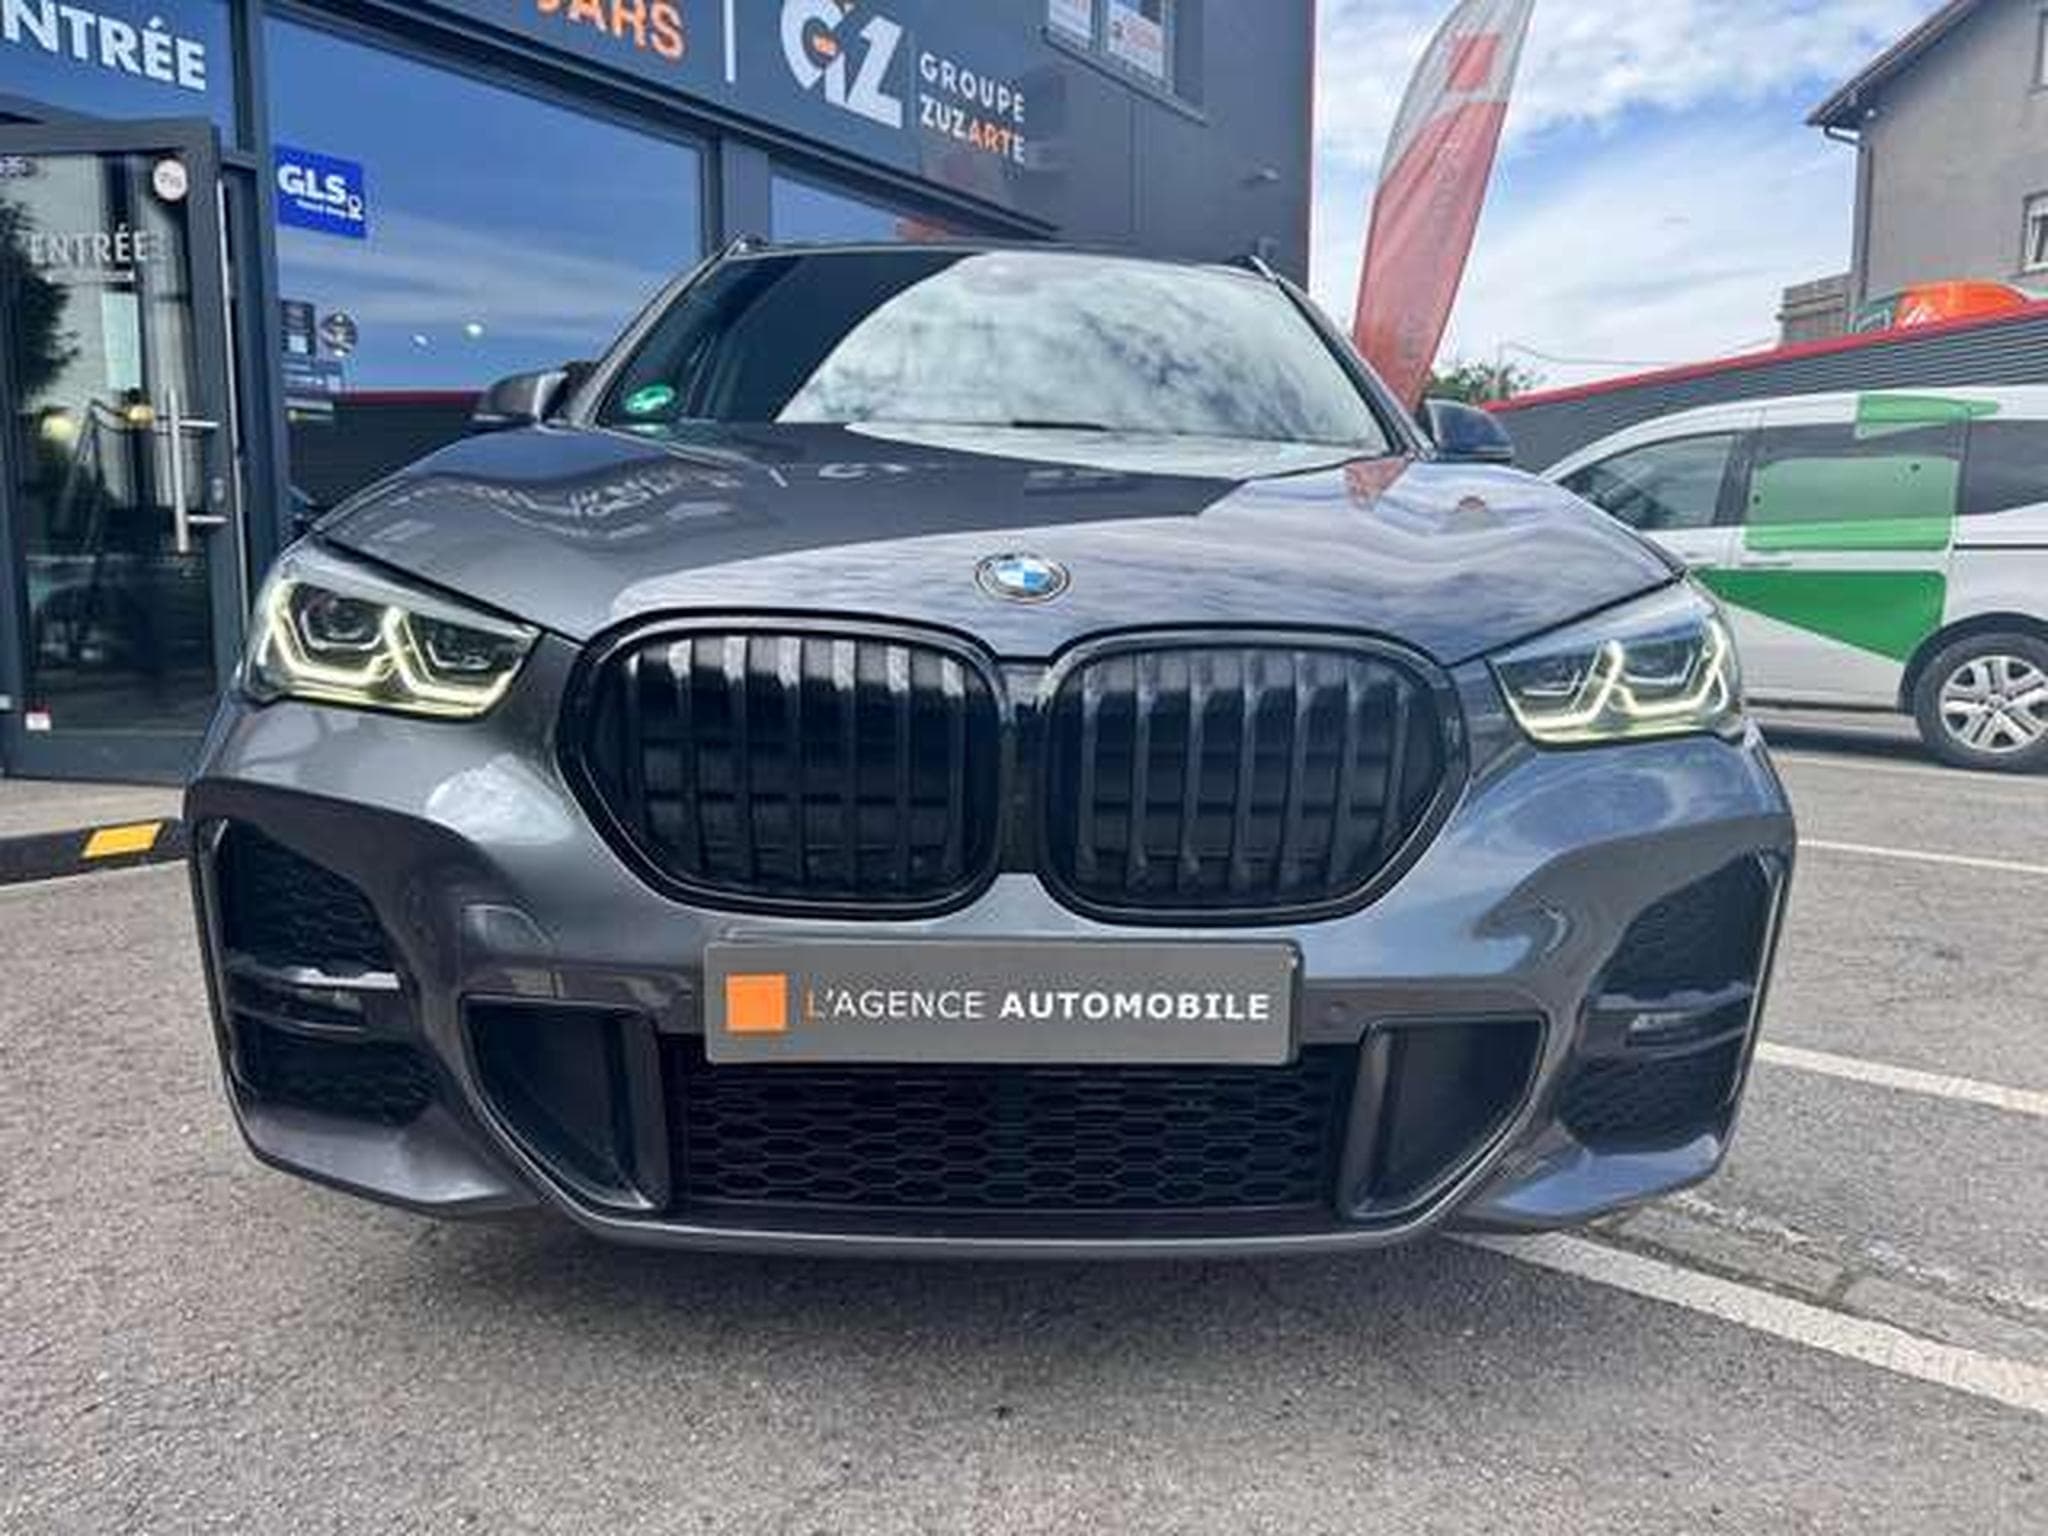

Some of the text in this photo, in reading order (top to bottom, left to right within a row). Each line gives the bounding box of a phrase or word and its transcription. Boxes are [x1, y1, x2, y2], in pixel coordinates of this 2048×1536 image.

[537, 0, 684, 60] ARS
[920, 51, 1025, 123] GROUPE
[920, 93, 1025, 164] ZUZARTE
[278, 163, 346, 205] GLS
[30, 222, 149, 265] ENTRÉE
[807, 989, 1272, 1021] L'AGENCE AUTOMOBILE
